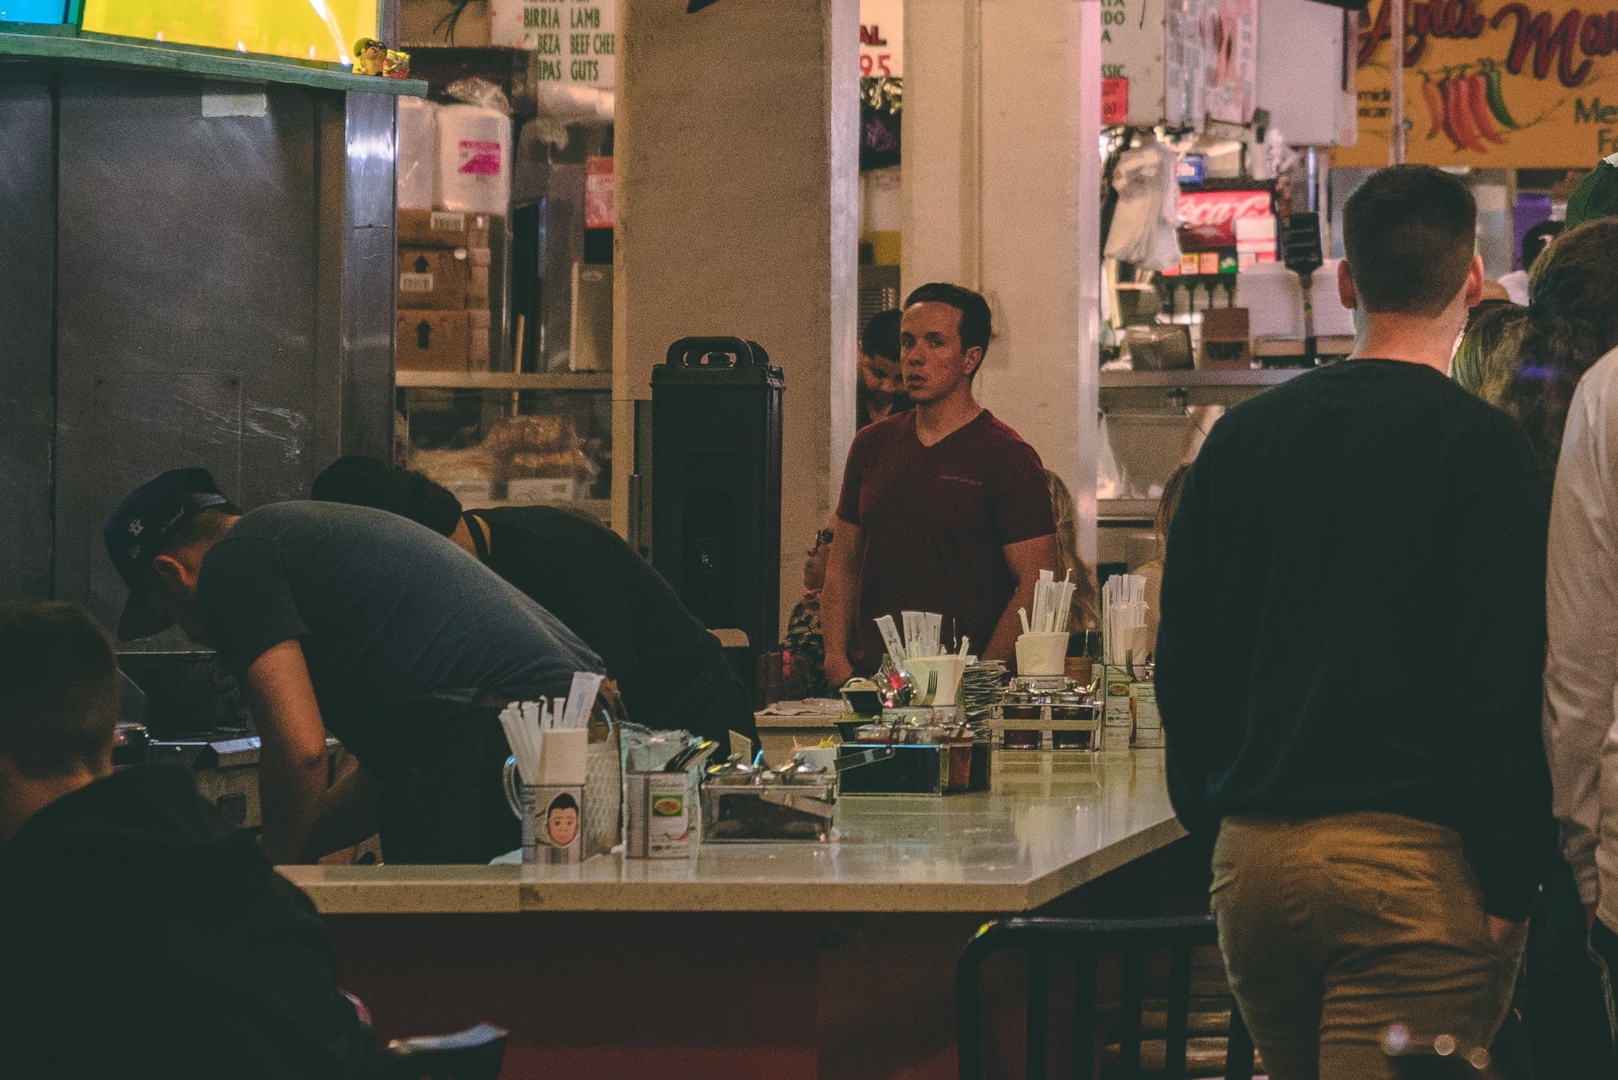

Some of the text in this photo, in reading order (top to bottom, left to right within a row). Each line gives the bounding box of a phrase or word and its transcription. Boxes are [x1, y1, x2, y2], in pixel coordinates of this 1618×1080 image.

[524, 7, 600, 28] BIRRIA LAMB
[570, 33, 590, 54] BEEF
[570, 60, 600, 81] GUTS
